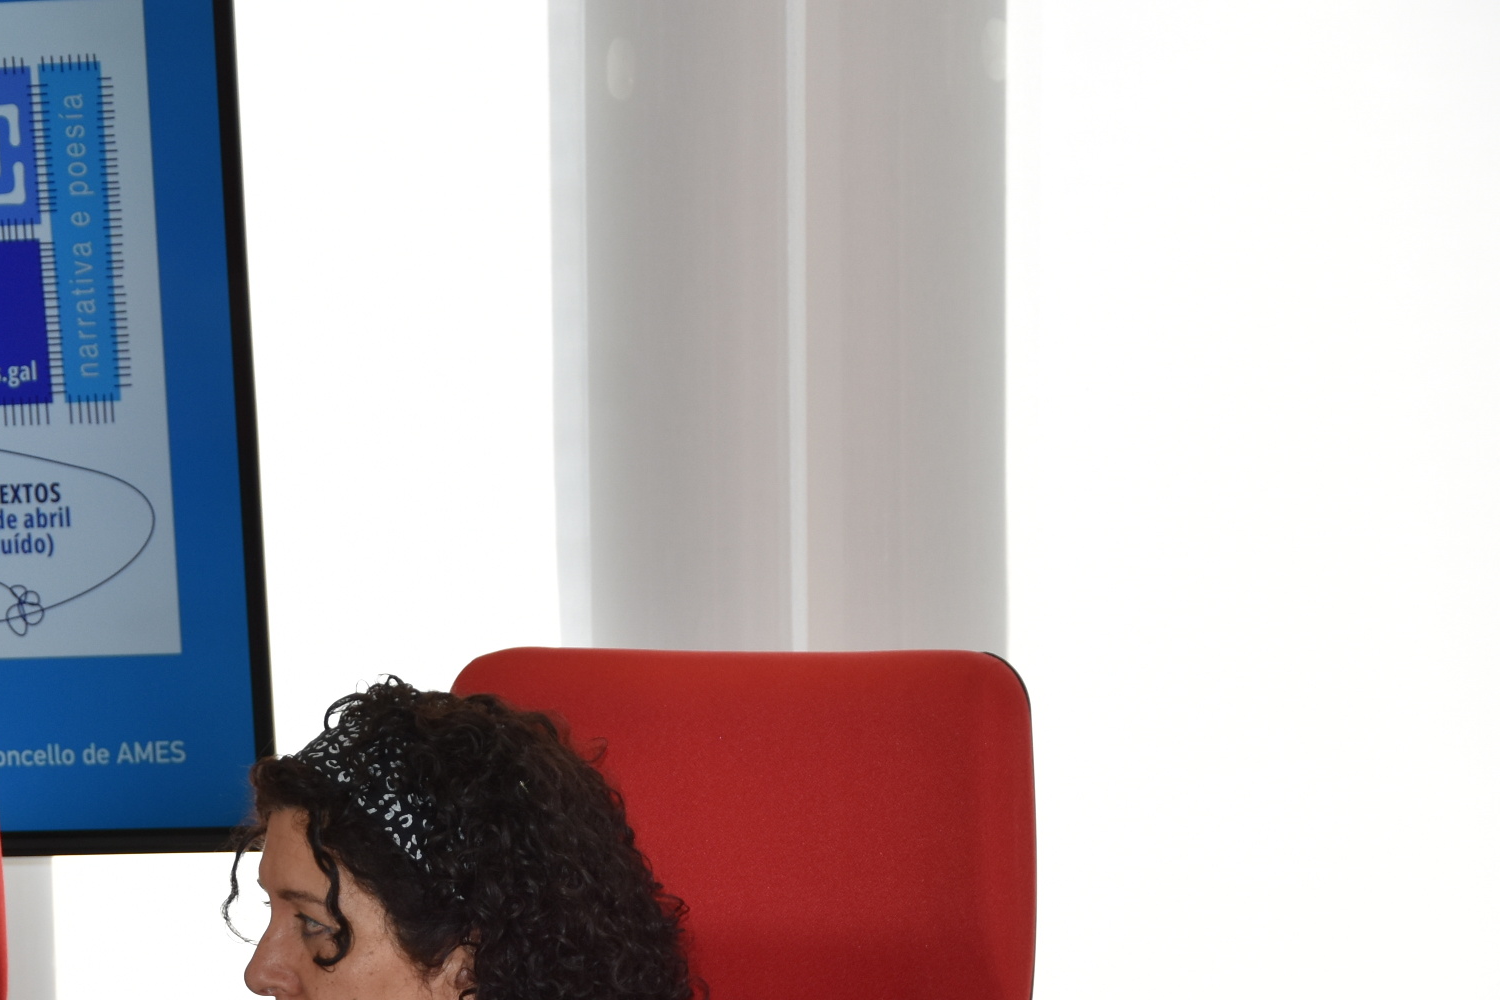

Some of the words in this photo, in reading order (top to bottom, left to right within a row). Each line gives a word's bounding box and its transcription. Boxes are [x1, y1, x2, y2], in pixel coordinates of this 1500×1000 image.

[59, 94, 95, 196] poesía
[71, 211, 90, 226] e
[72, 241, 98, 378] narrativa
[24, 507, 71, 528] abril
[82, 743, 109, 764] de
[116, 741, 186, 764] AMES
